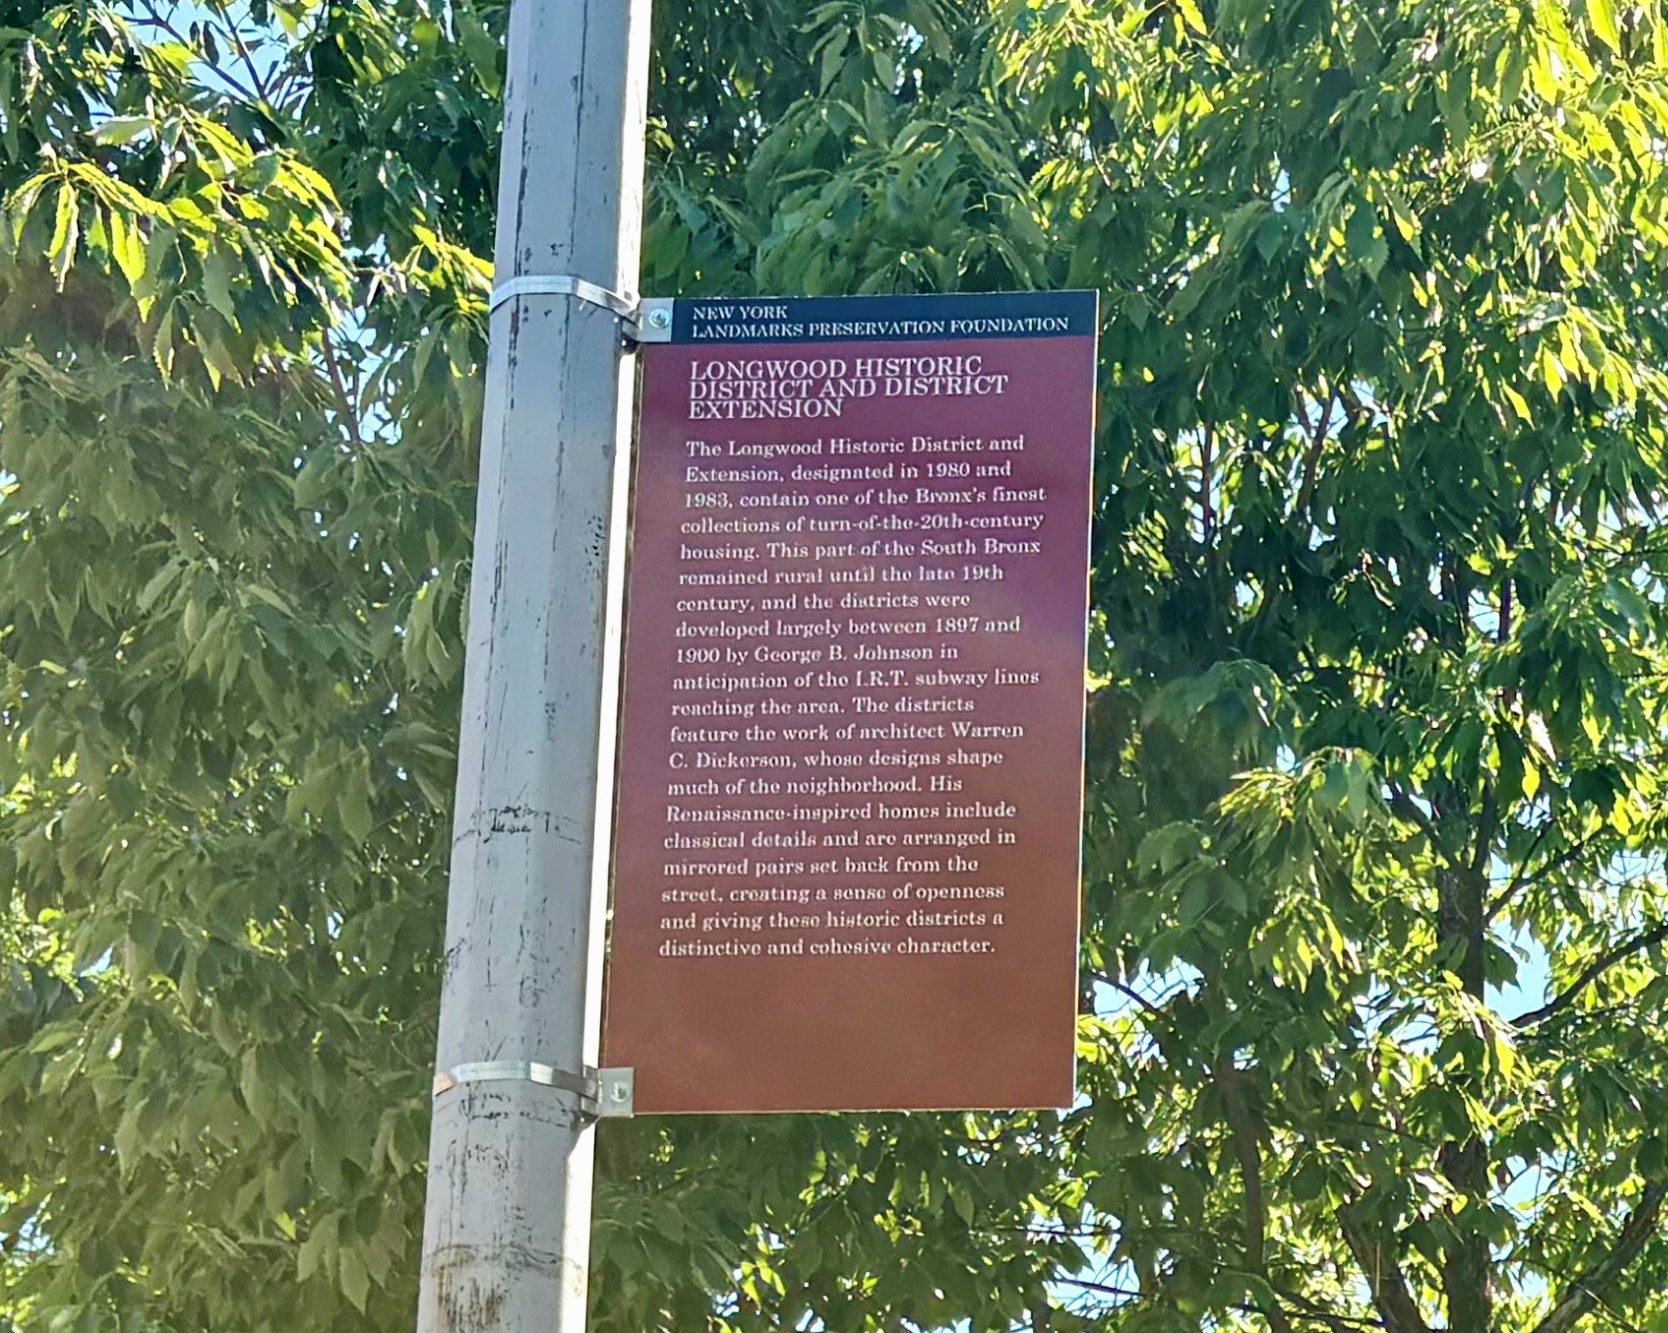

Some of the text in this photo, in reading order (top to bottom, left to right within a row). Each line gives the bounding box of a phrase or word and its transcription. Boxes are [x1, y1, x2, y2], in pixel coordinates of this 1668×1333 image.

[693, 306, 787, 320] NEW YORK
[693, 317, 1068, 338] LANDMARKS PRESERVATION FOUNDATION
[691, 357, 981, 380] LONGWOOD HISTORIC
[690, 376, 1008, 400] DISTRICT AND DISTRICT
[688, 399, 842, 417] EXTENSION
[686, 434, 1023, 458] The Longwood Historic District and
[791, 463, 893, 483] designated
[901, 463, 918, 478] in
[927, 463, 970, 477] 1980
[976, 460, 1010, 477] and
[740, 491, 809, 507] contain
[815, 494, 849, 505] one
[855, 489, 874, 504] of
[879, 488, 908, 504] the
[993, 486, 1046, 502] finest
[681, 517, 780, 533] collections
[786, 516, 805, 532] of
[681, 538, 1040, 561] housing. This part of the South Bronx
[680, 564, 1003, 585] remained rural until the late 19th
[762, 594, 796, 609] and
[804, 594, 832, 609] the
[841, 592, 918, 608] districts
[926, 596, 970, 607] were
[676, 616, 1020, 640] developed largely between 1897 and
[678, 643, 957, 665] 1900 by George B. Johnson in
[673, 672, 787, 692] anticipation
[794, 672, 813, 687] of
[819, 671, 848, 687] the
[916, 669, 987, 688] subway
[995, 669, 1038, 684] lines
[672, 696, 974, 718] reaching the area. The districts
[671, 722, 1023, 742] feature the work of architect Warren
[669, 753, 688, 768] C.
[804, 750, 862, 766] whose
[869, 749, 940, 768] designs
[947, 748, 1003, 767] shape
[668, 775, 962, 796] much of the neighborhood. His
[879, 803, 939, 819] homes
[947, 801, 1016, 818] include
[664, 828, 1015, 849] classical details and are arranged in
[664, 855, 978, 877] mirrored pairs set back from the
[730, 888, 810, 904] creating
[816, 889, 826, 900] a
[834, 888, 885, 900] sense
[893, 883, 912, 899] of
[916, 887, 1004, 902] openness
[661, 910, 1002, 931] and giving these historic districts a
[659, 937, 995, 956] distinctive and cohesive character.
